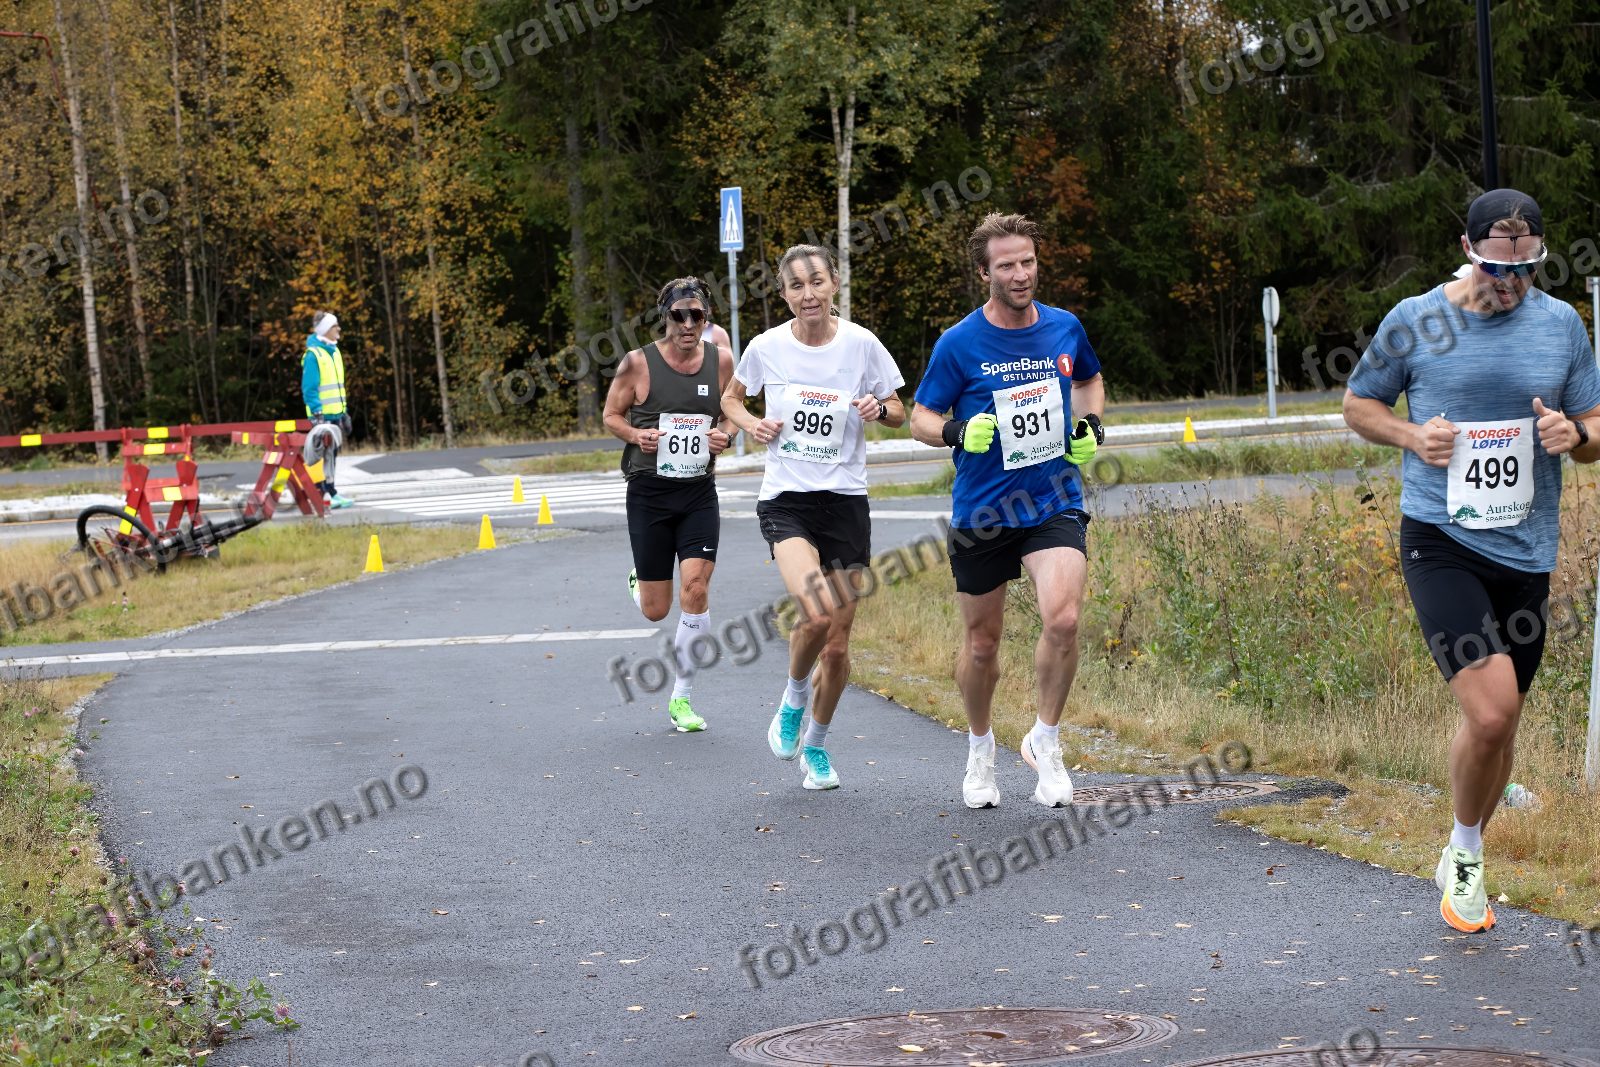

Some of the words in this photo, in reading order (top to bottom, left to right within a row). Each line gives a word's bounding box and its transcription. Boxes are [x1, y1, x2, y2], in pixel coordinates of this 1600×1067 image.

[980, 356, 1055, 376] SpareBank
[1061, 357, 1070, 372] 1
[1002, 371, 1057, 382] ØSTLANDET
[799, 390, 839, 402] NORGES
[1010, 386, 1049, 402] NORGES
[1014, 394, 1044, 408] LØPET
[801, 397, 832, 408] LØPET
[671, 417, 704, 425] NORGES
[793, 410, 834, 437] 996
[1011, 408, 1051, 439] 931
[1466, 427, 1521, 440] NORGES
[668, 434, 701, 455] 618
[1471, 437, 1513, 449] LØPET
[803, 444, 838, 457] Aurskog
[1464, 455, 1519, 490] 499
[1485, 500, 1531, 515] Aurskog
